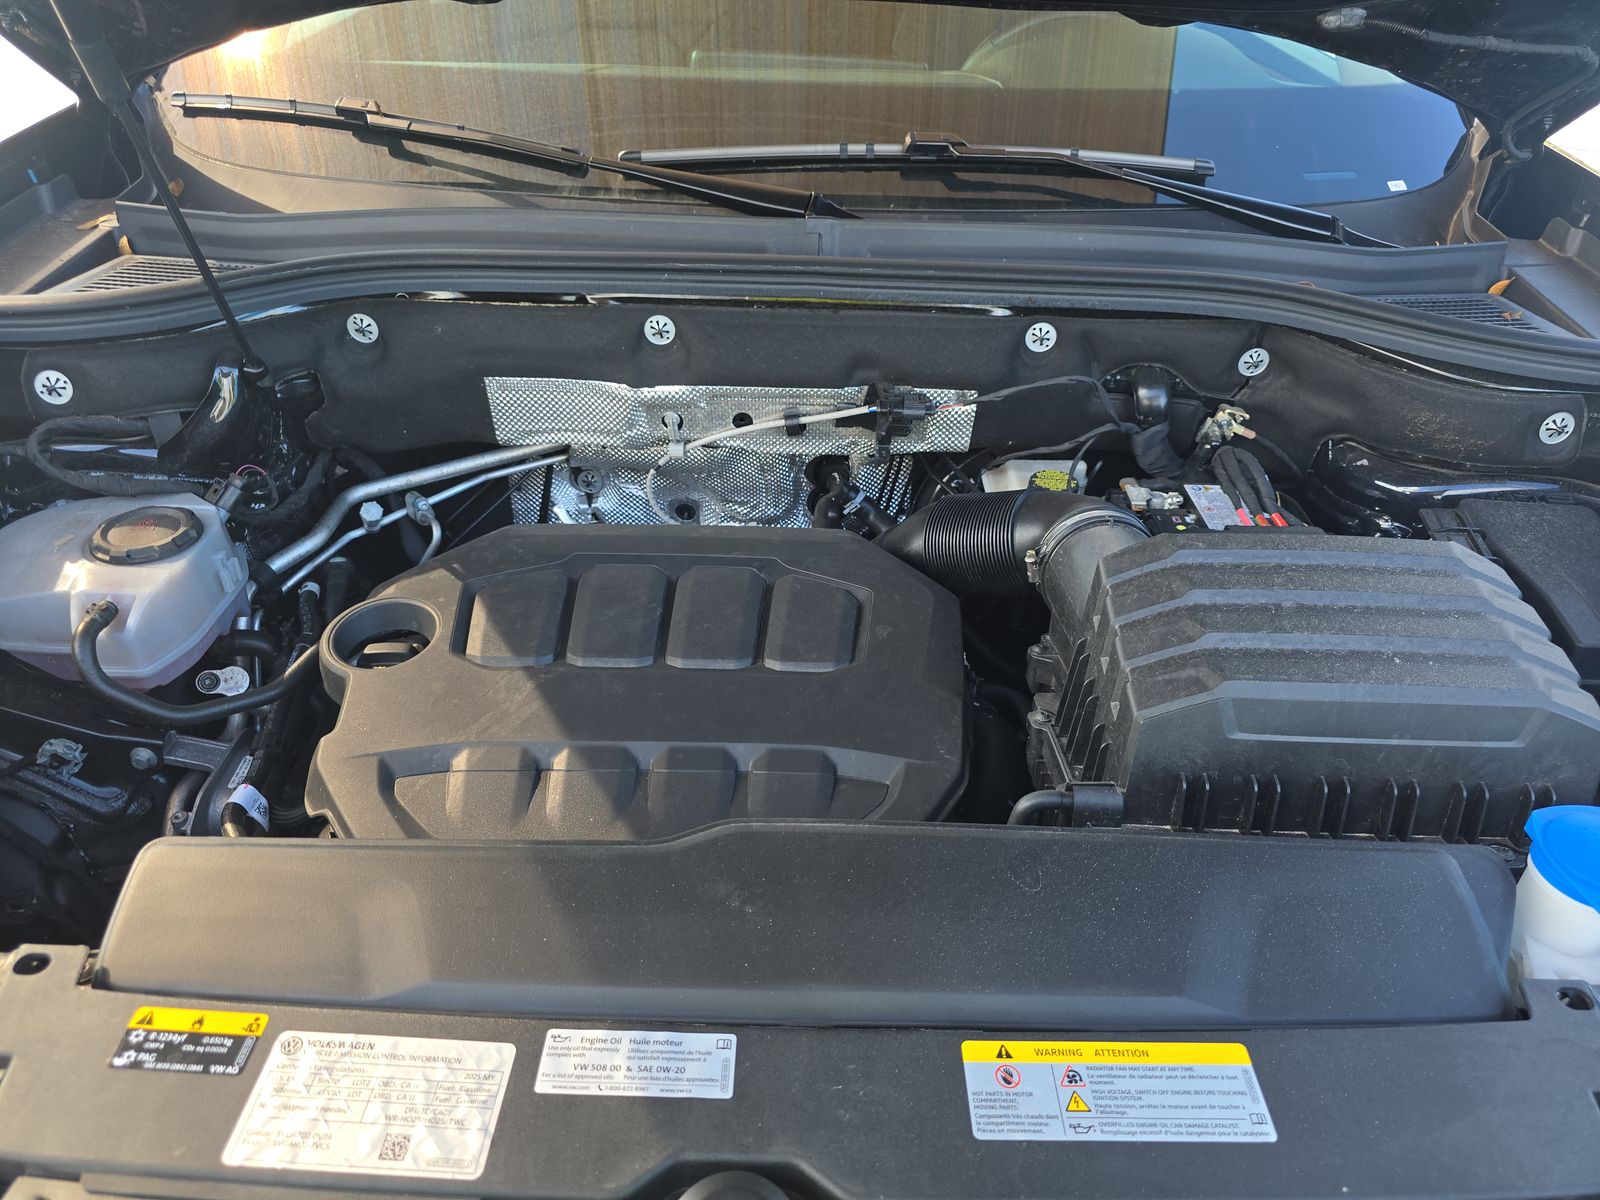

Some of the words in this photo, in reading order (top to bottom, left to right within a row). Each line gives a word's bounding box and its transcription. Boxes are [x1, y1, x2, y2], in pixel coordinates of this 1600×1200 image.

[149, 1031, 189, 1044] R-1234yf
[223, 1037, 233, 1047] kg
[580, 1036, 609, 1046] Engine
[610, 1036, 623, 1045] Oil
[629, 1037, 652, 1046] Huile
[652, 1038, 683, 1047] moteur
[307, 1039, 376, 1051] VOLKSWAGEN
[138, 1052, 157, 1061] PAG
[1033, 1048, 1083, 1057] WARNING
[1094, 1048, 1149, 1058] ATTENTION
[408, 1054, 463, 1065] INFORMATION
[210, 1064, 225, 1074] VW
[226, 1065, 239, 1074] AG
[573, 1063, 590, 1071] VW
[591, 1063, 608, 1072] 508
[609, 1064, 622, 1072] 00
[637, 1065, 654, 1073] SAE
[656, 1065, 686, 1074] 0W-20
[464, 1073, 481, 1081] 2025
[400, 1081, 412, 1089] CA
[438, 1083, 456, 1092] Fuel:
[459, 1085, 492, 1094] Gasoline
[975, 1112, 1011, 1120] Composants
